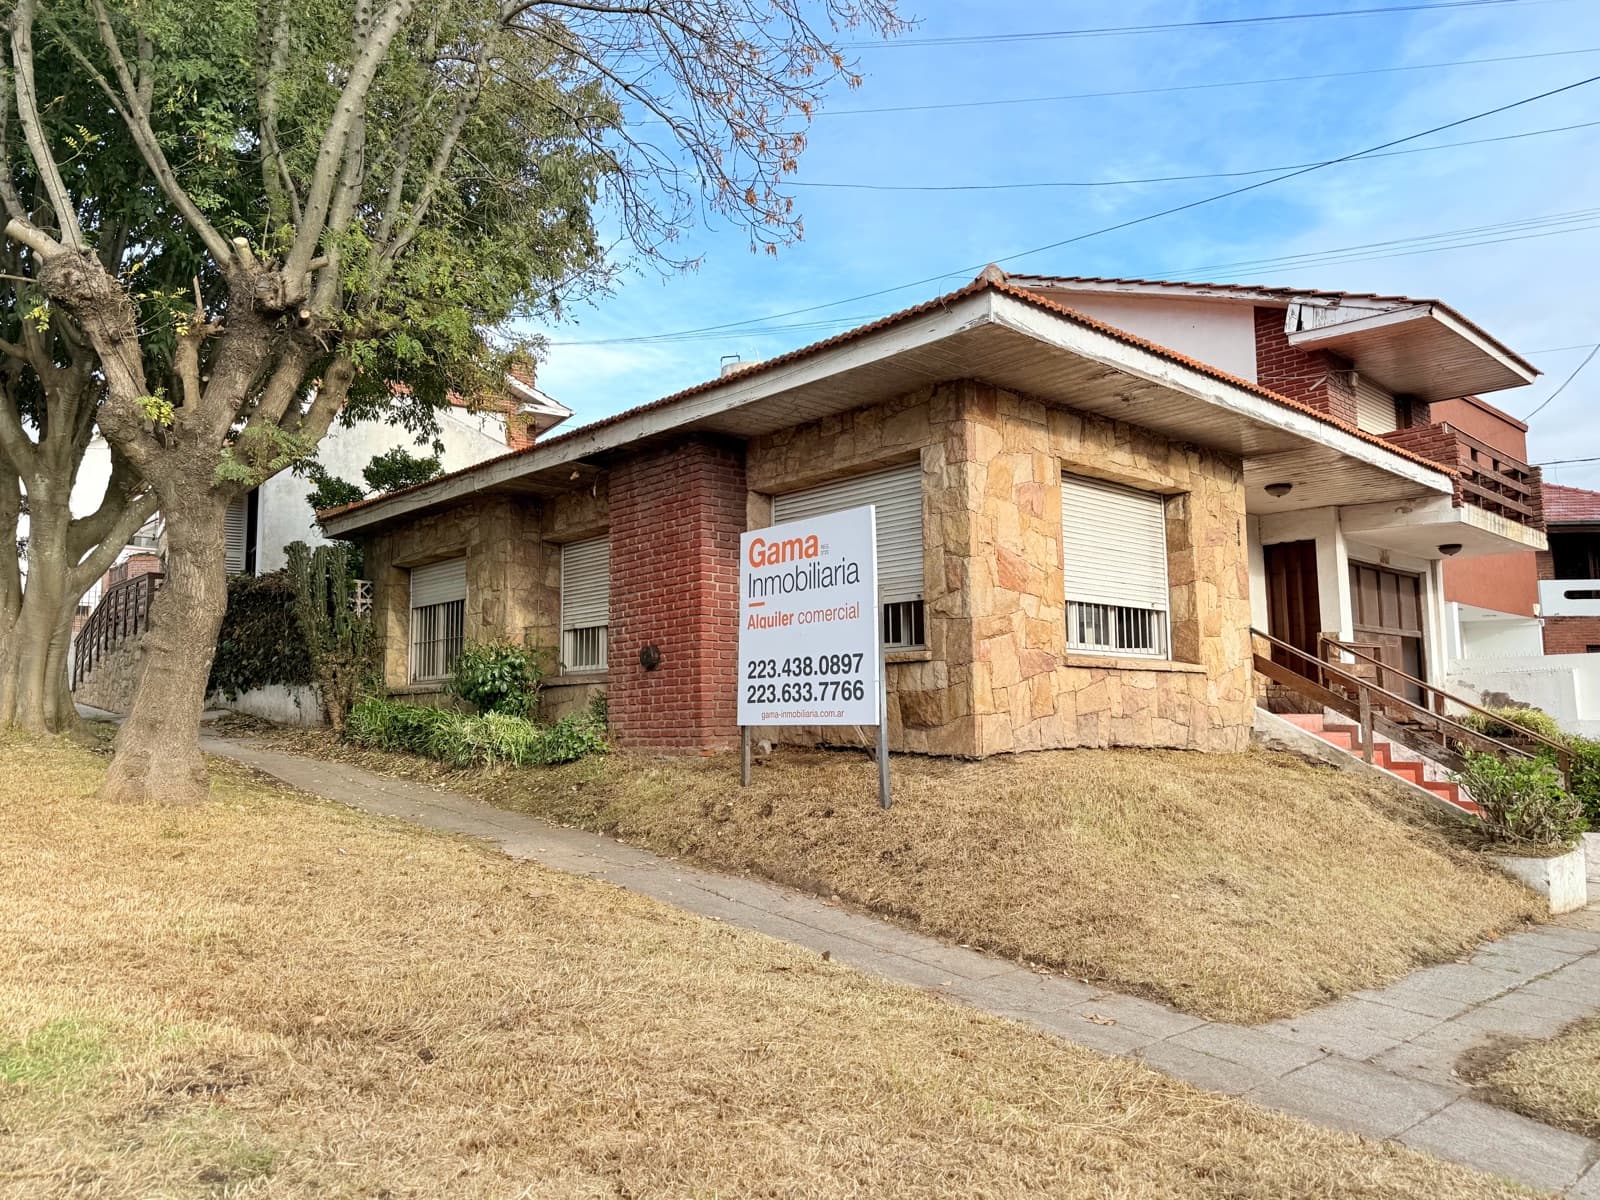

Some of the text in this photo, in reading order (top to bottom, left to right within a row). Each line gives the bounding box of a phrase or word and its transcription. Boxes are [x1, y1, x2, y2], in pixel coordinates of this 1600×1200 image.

[749, 534, 819, 569] Gama
[748, 557, 860, 599] Inmobiliaria
[747, 601, 860, 631] Alquiler comercial
[747, 653, 864, 679] 223.438.0897
[747, 680, 865, 704] 223.633.7766
[761, 709, 844, 721] gama-inmobiliaria.com.ar
